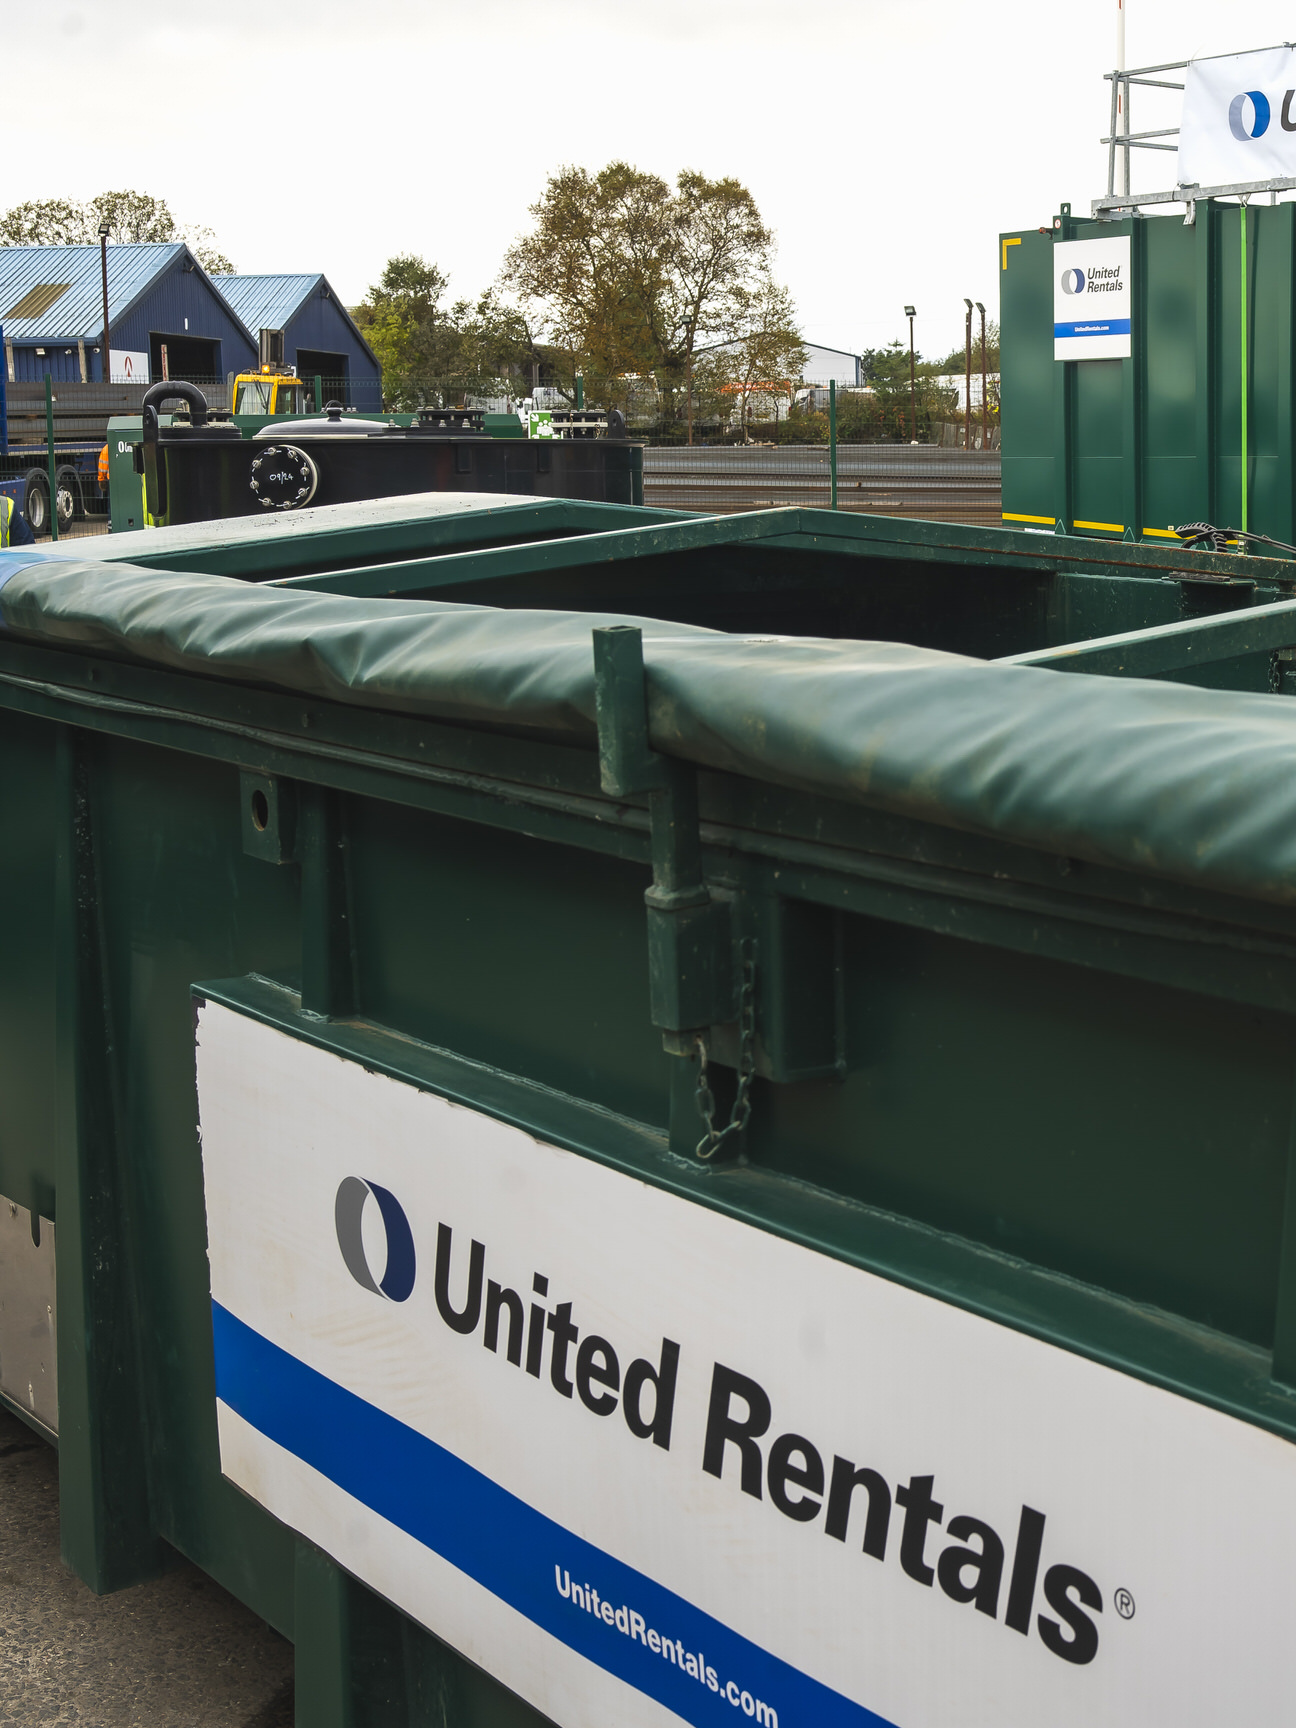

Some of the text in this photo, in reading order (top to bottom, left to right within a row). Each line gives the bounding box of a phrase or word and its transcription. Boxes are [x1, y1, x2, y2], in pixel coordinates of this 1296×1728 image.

[1087, 266, 1120, 280] United
[1087, 279, 1123, 293] Rentals
[432, 1221, 681, 1452] United
[554, 1564, 779, 1728] UnitedRentals.com
